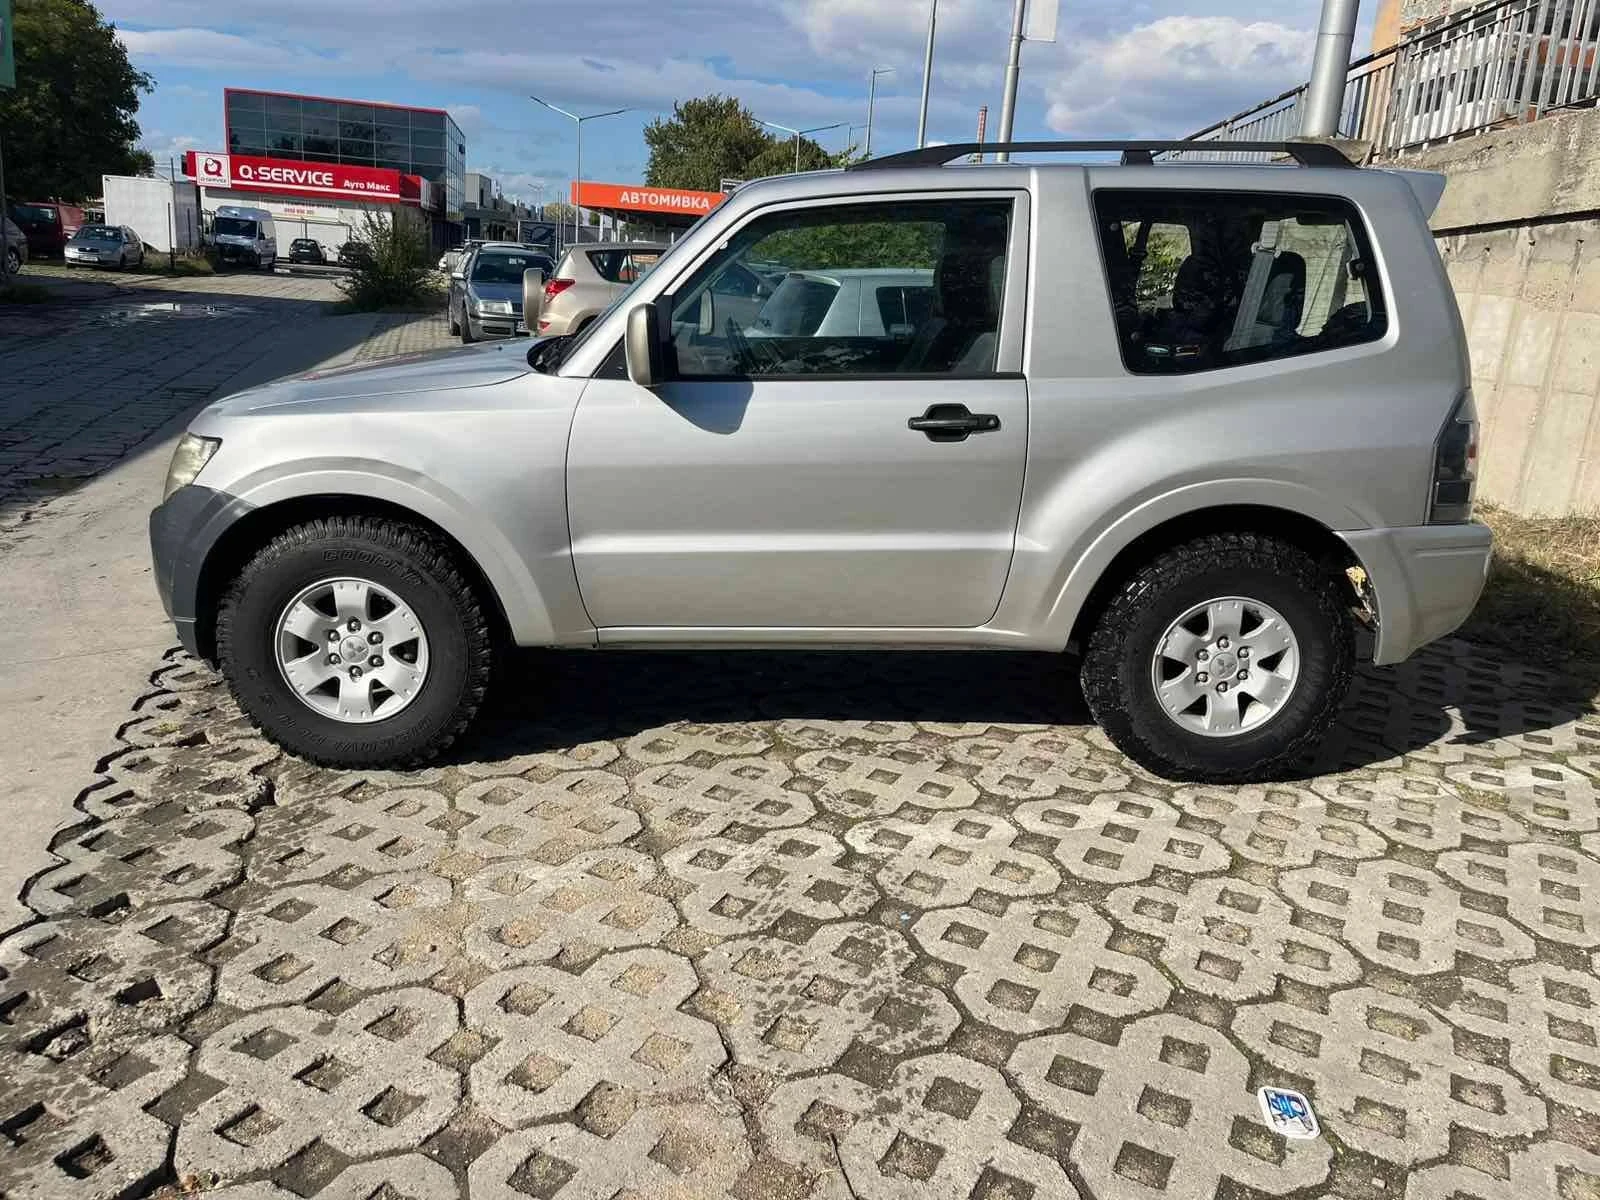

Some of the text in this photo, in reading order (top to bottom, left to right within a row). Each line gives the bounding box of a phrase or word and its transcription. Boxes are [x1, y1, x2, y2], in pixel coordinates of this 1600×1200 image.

[343, 179, 391, 192] Ауто Макс
[620, 191, 710, 209] АВТОМИВКА
